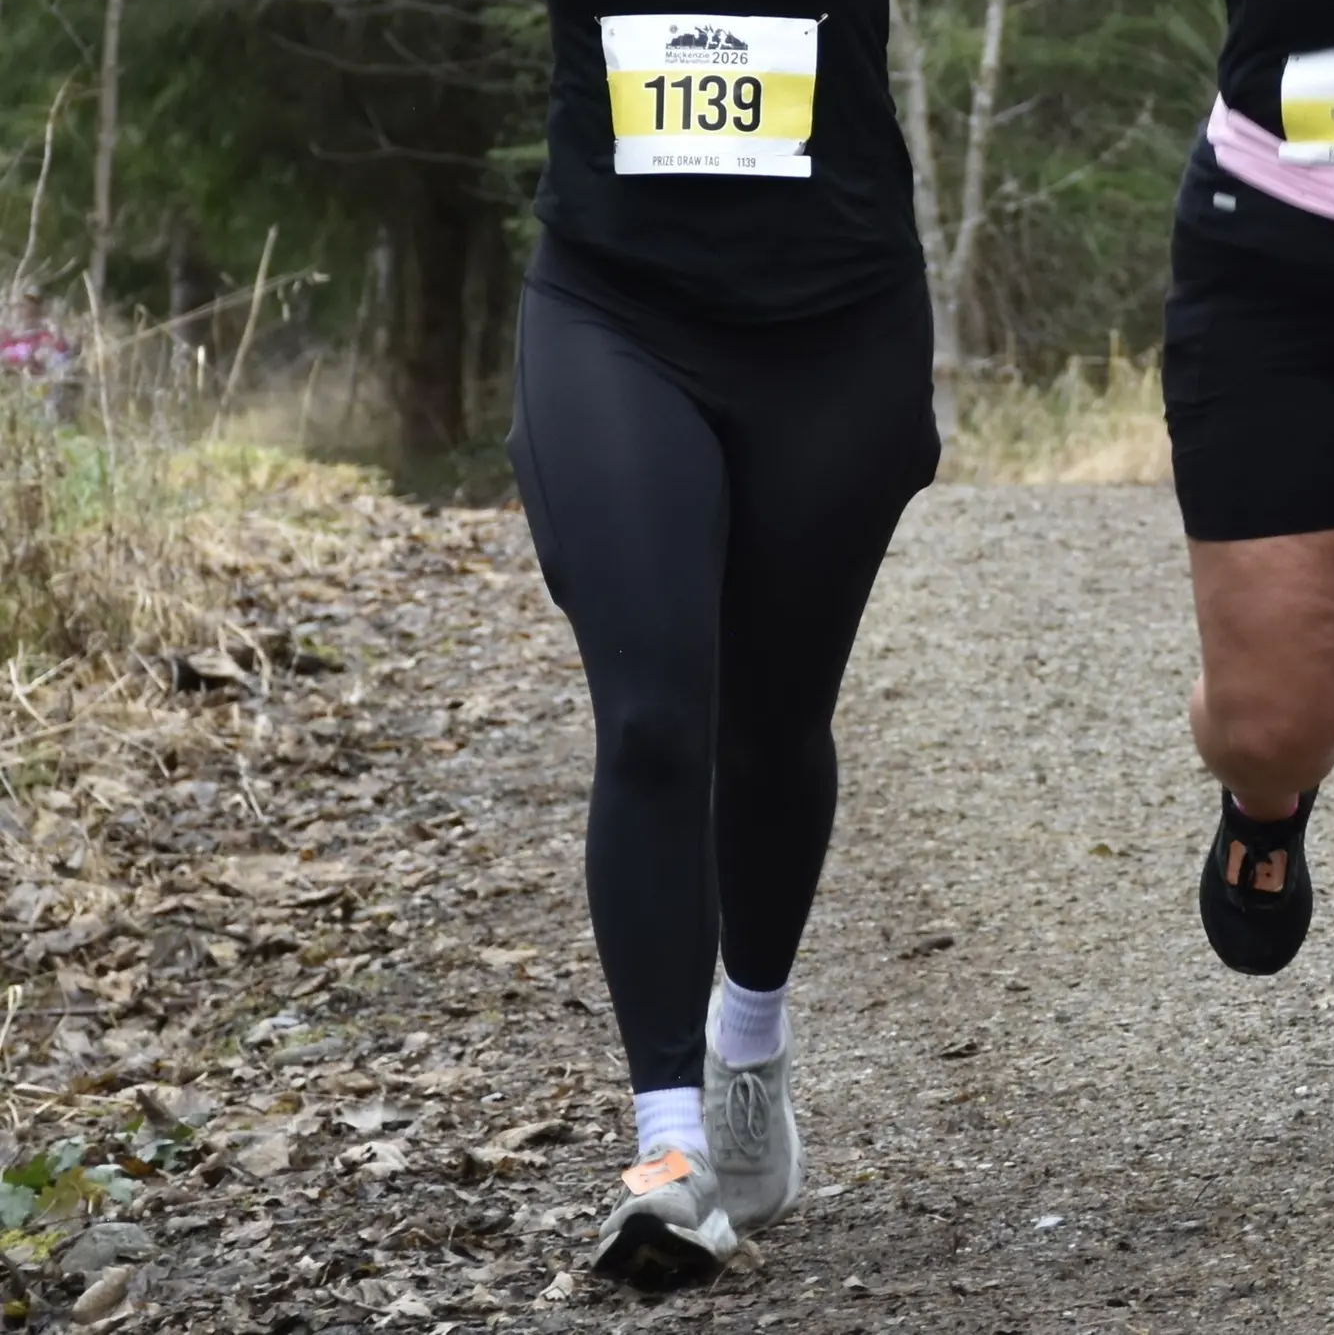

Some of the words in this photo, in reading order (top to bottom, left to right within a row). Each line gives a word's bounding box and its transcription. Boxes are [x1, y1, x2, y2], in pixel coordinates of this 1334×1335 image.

[665, 51, 710, 59] Mackenzie
[712, 51, 749, 65] 2026
[644, 74, 762, 133] 1139
[652, 155, 674, 167] PRIZE
[677, 155, 702, 167] DRAW
[704, 156, 720, 167] TAG
[737, 157, 756, 168] 1139
